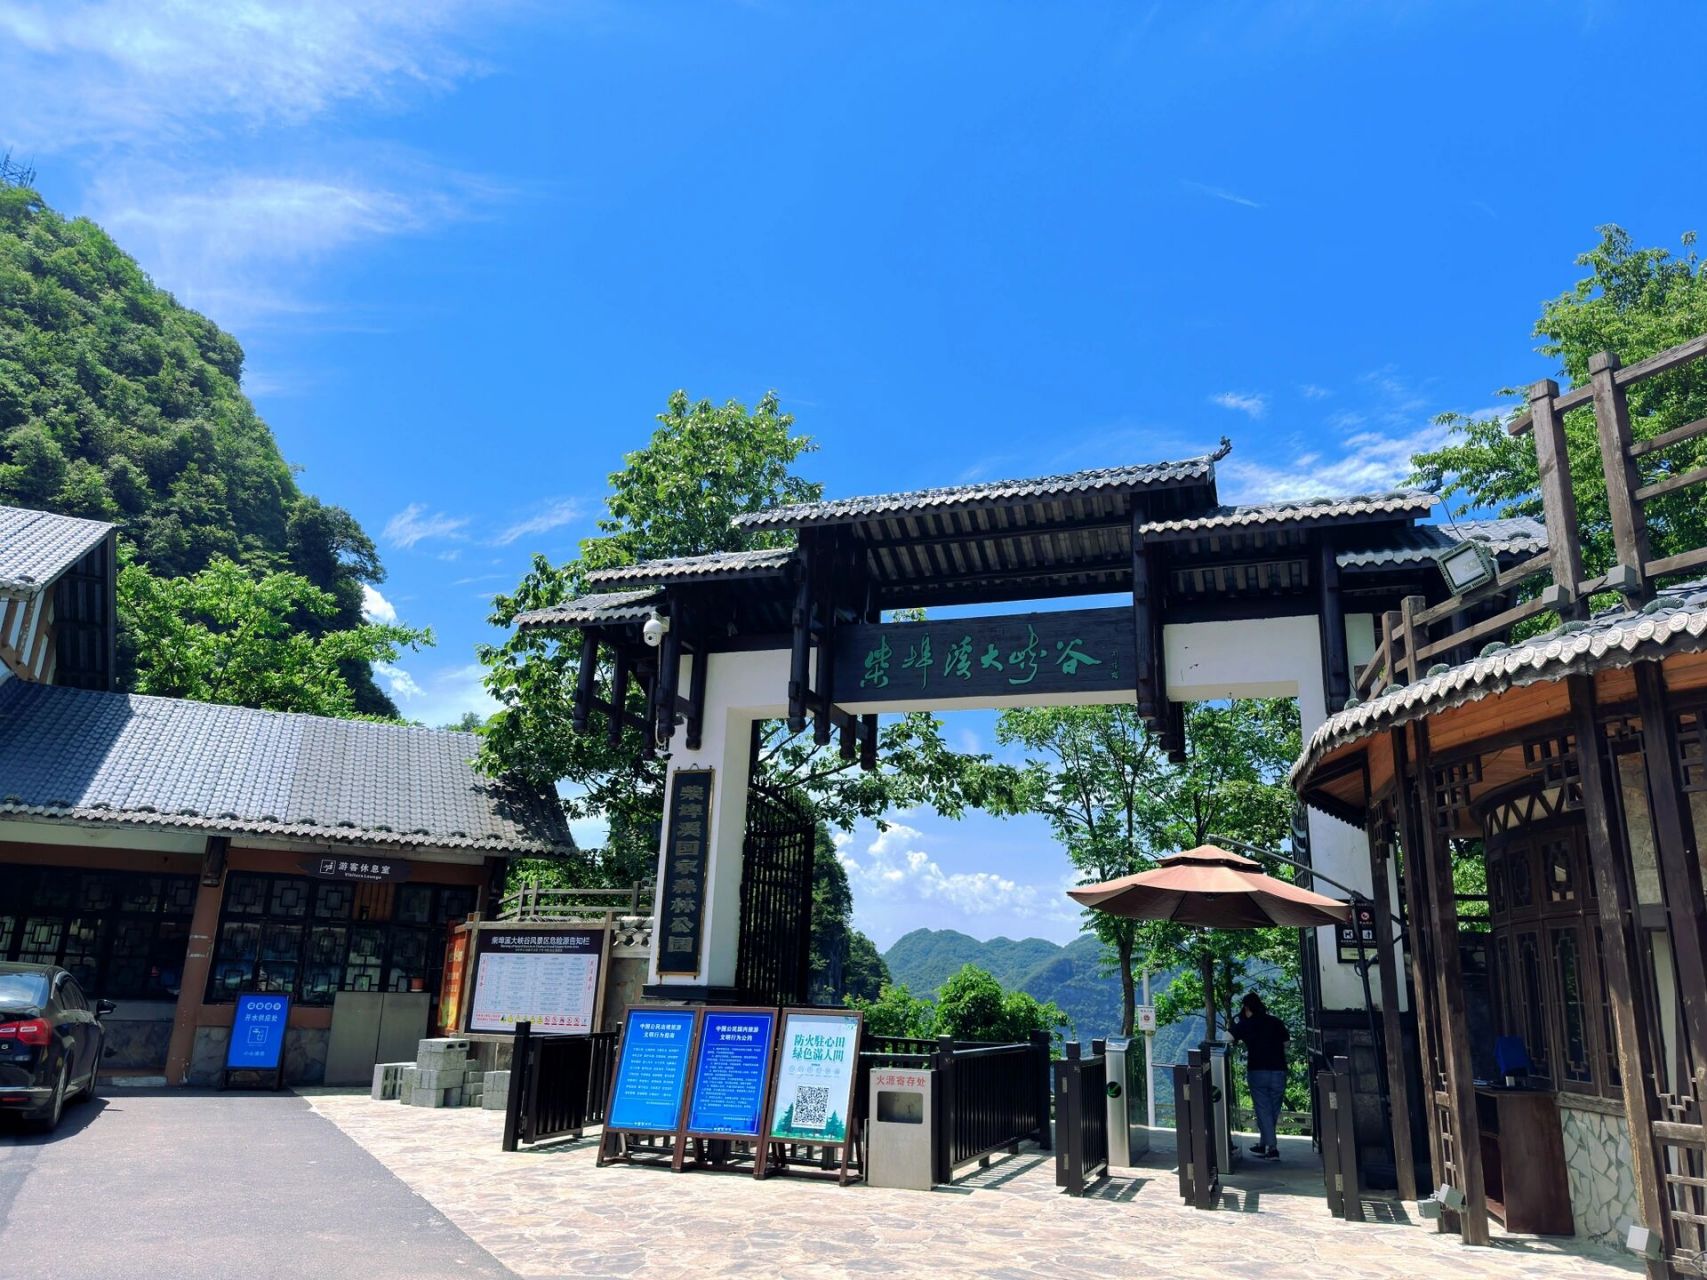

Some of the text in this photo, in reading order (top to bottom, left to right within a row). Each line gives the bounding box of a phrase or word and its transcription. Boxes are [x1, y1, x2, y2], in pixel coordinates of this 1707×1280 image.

[339, 862, 391, 874] 游客休息室
[875, 1074, 927, 1088] 火源寄存处
